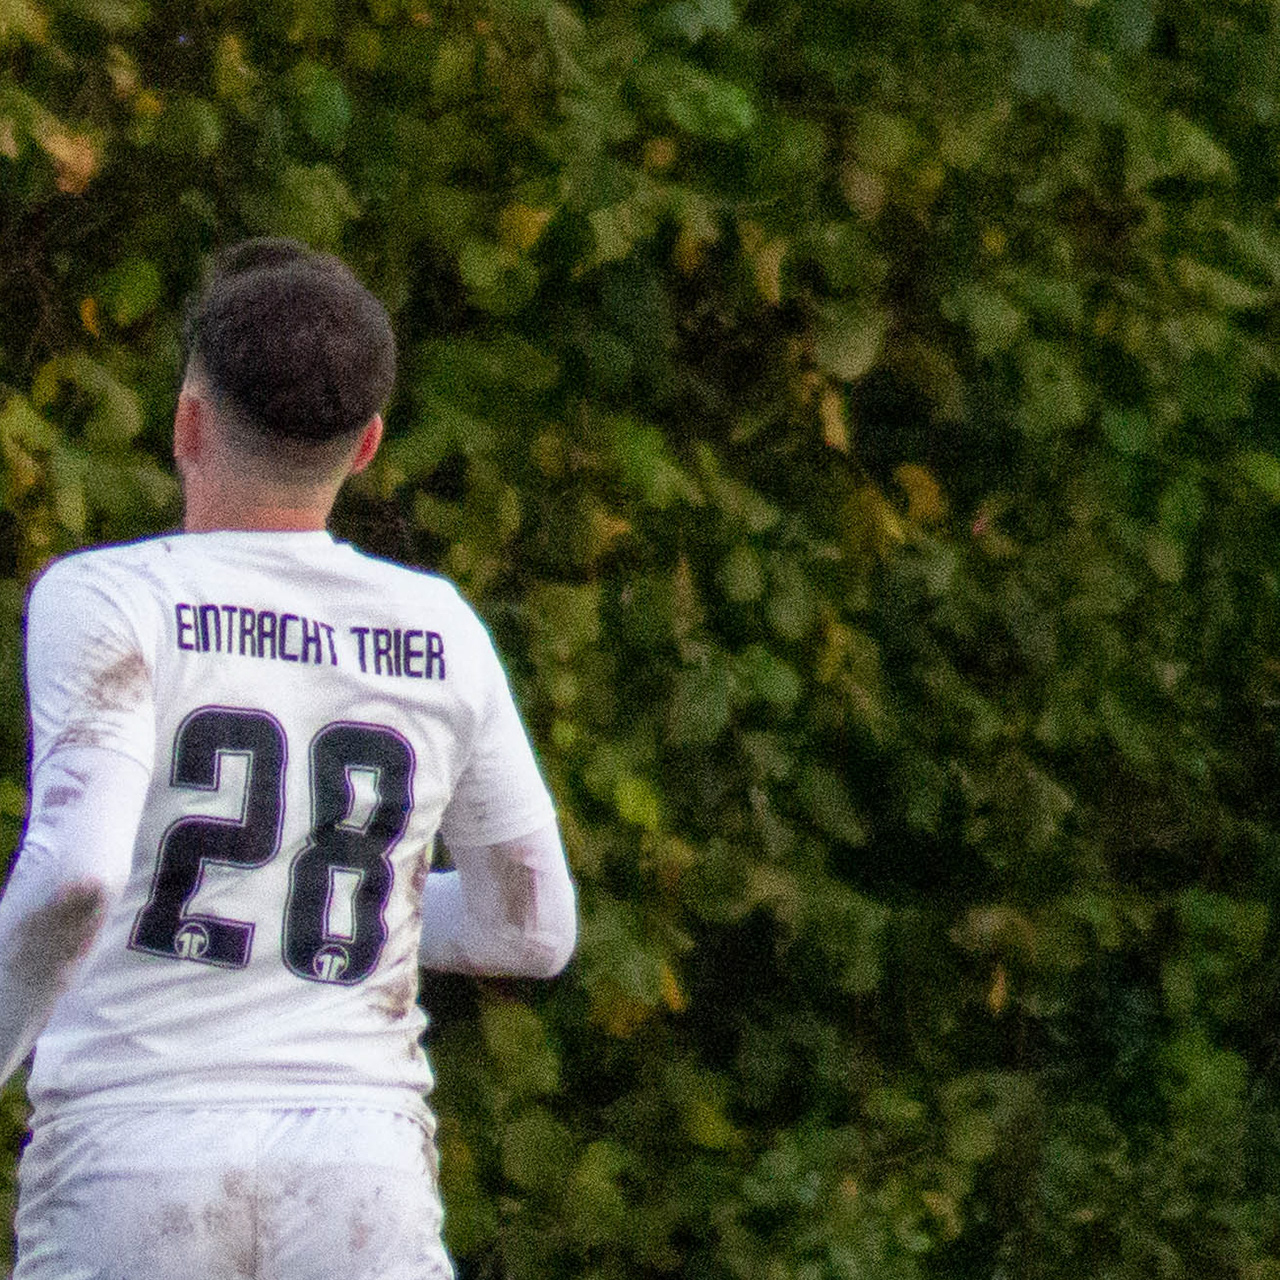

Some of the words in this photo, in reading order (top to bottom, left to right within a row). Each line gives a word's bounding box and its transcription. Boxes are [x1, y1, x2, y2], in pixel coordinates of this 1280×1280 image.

[175, 603, 338, 667] EINTRACHT
[349, 626, 446, 681] TRIER
[126, 704, 417, 987] 28
